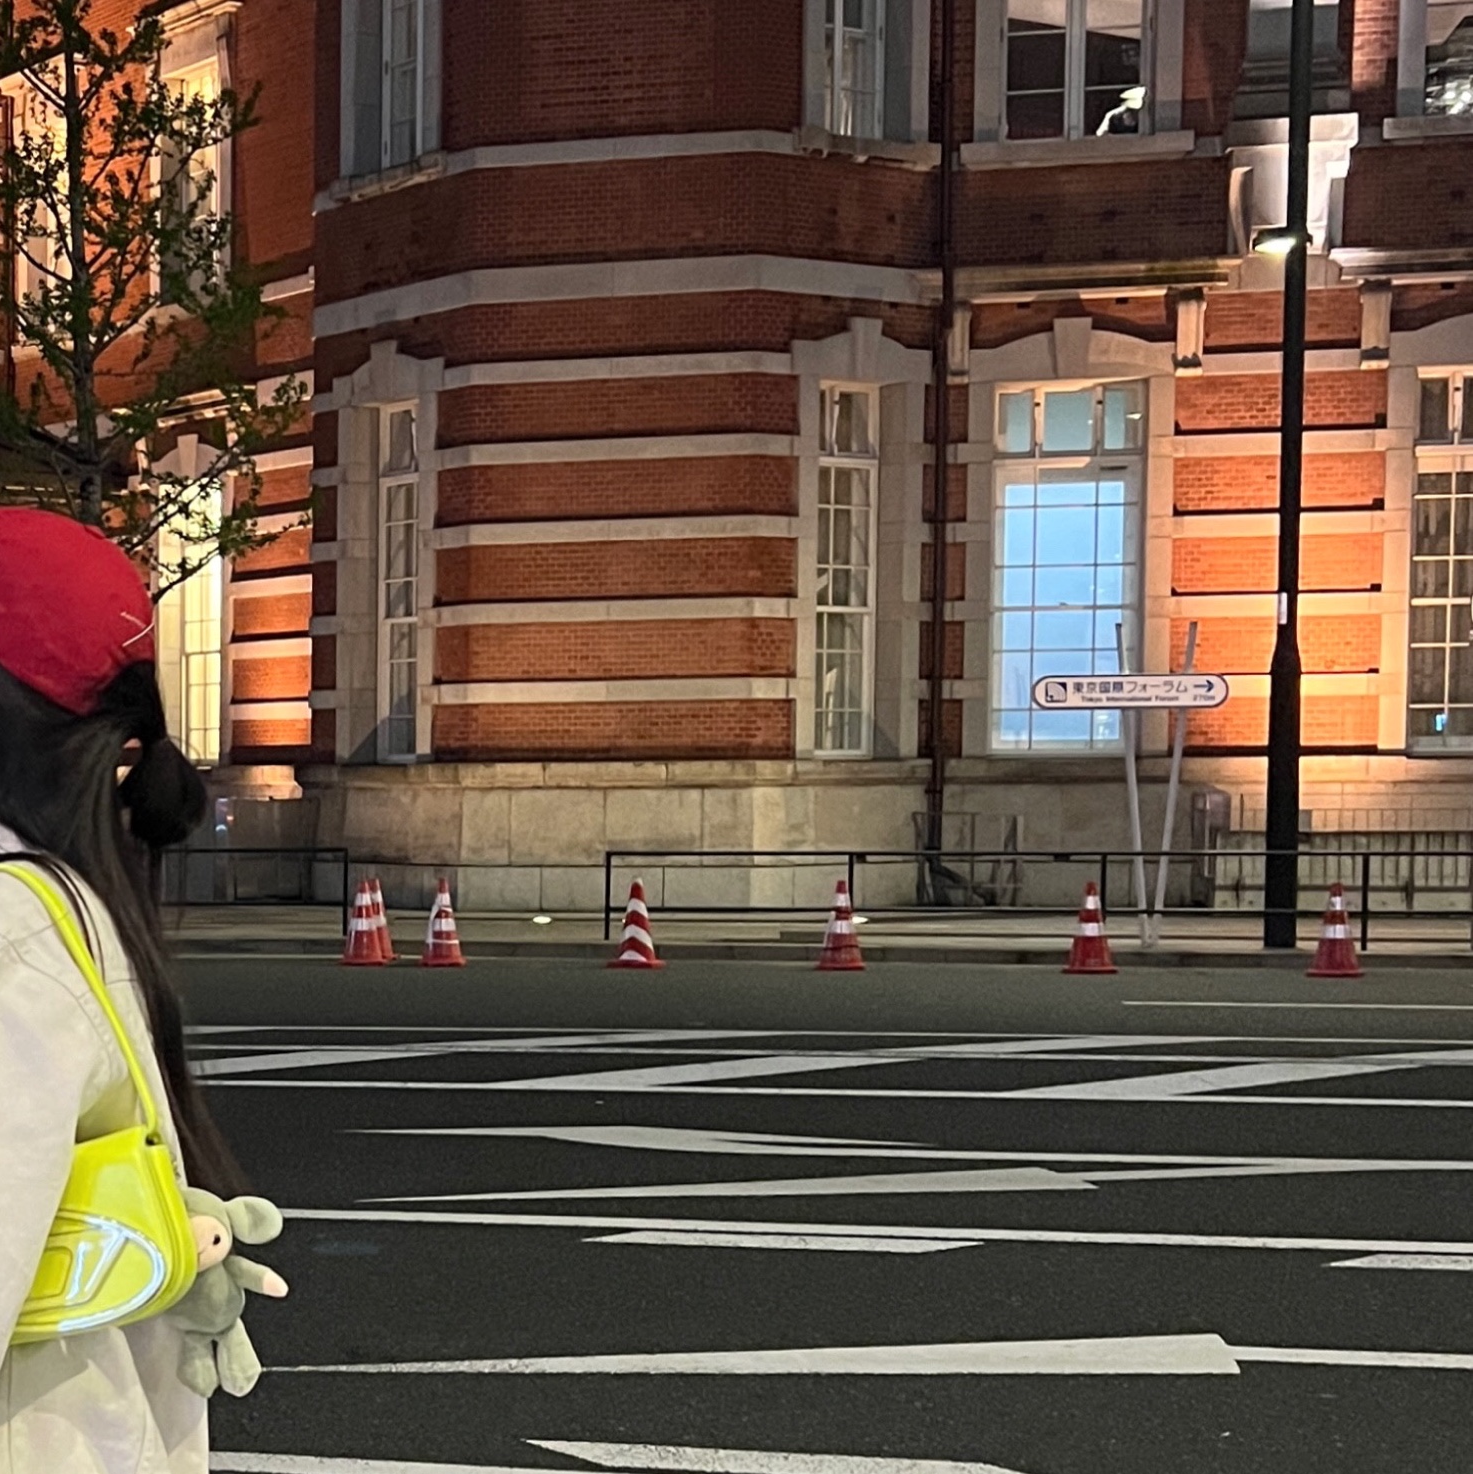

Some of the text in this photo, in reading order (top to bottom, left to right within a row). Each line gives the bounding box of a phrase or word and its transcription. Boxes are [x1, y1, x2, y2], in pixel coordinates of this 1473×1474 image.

[1073, 680, 1188, 694] 東京国際フォーラム
[1081, 695, 1104, 703] Tokyo
